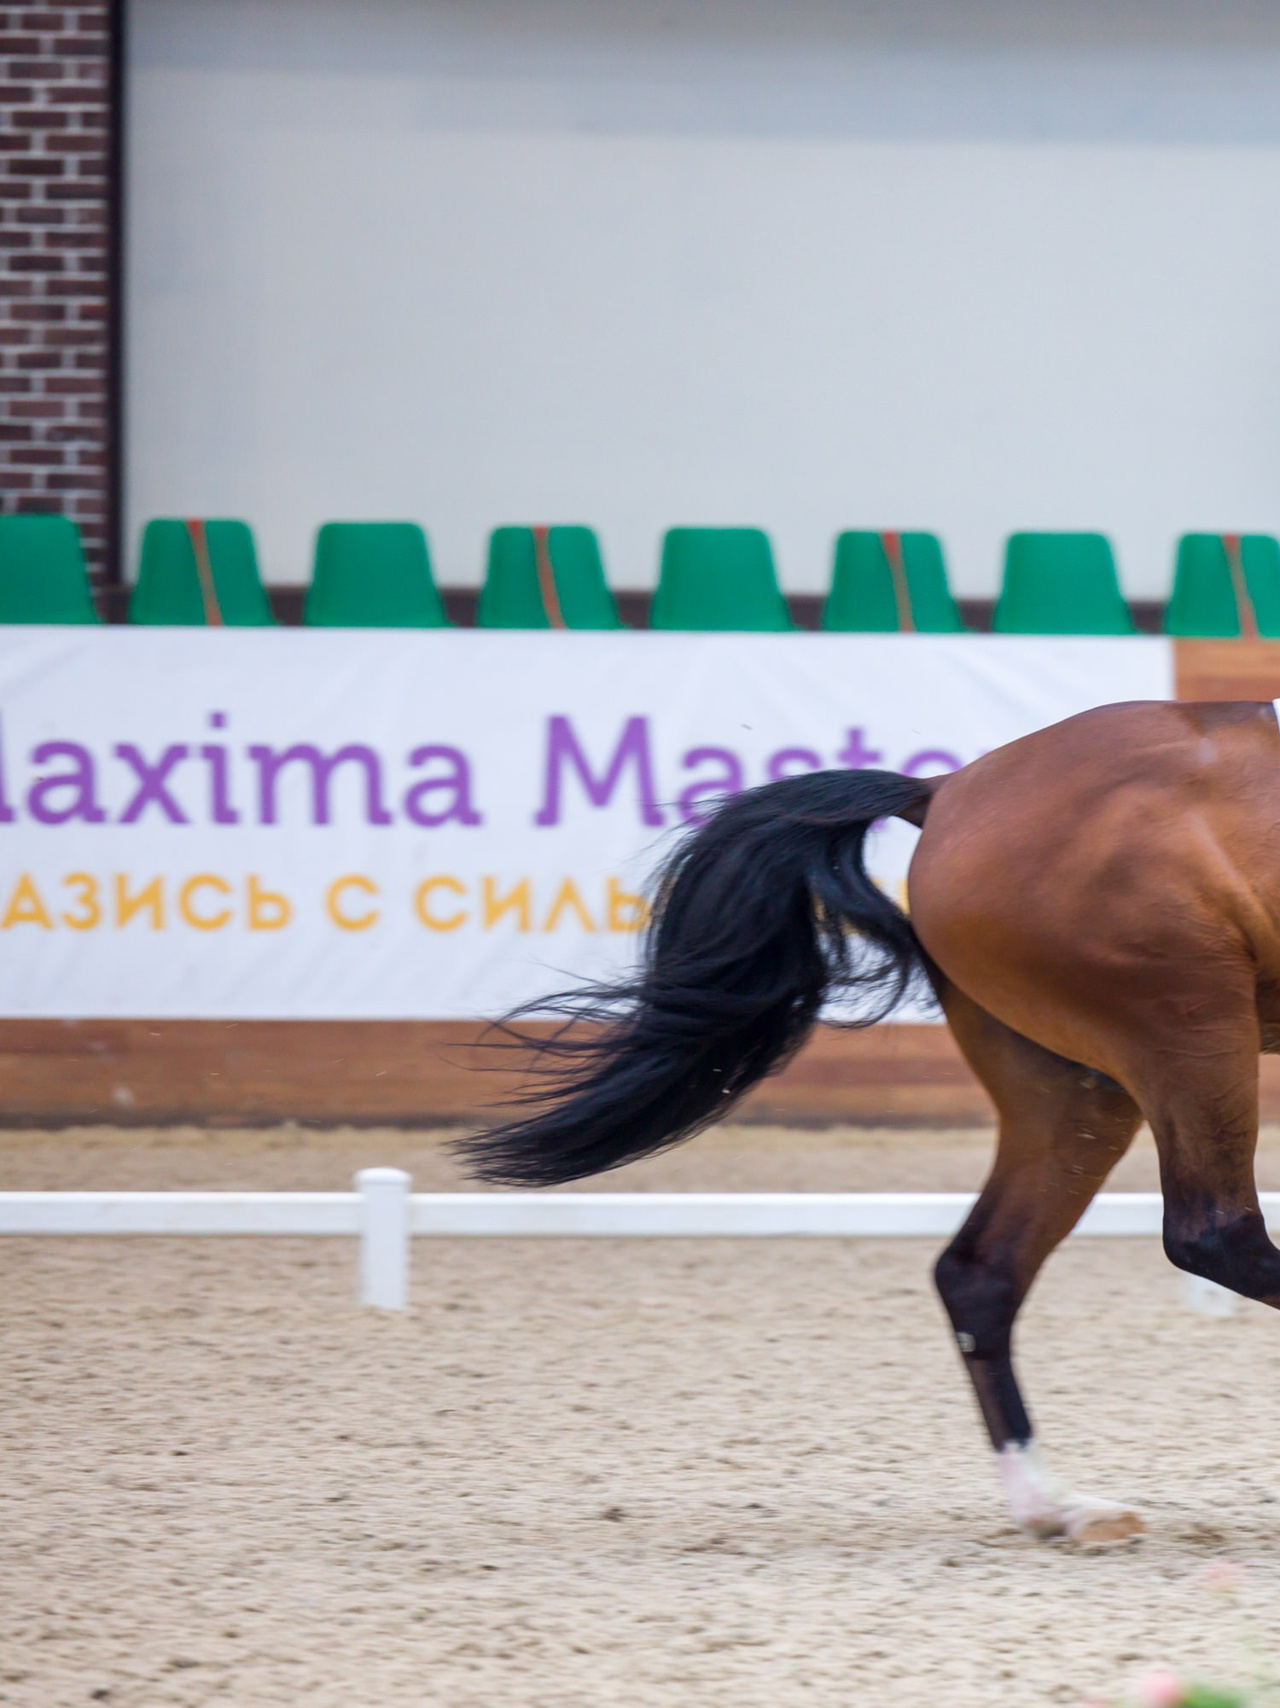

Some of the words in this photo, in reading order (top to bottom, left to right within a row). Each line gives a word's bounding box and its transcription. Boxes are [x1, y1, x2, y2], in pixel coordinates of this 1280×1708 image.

[0, 711, 482, 827] axima
[0, 872, 293, 932] АЗИСЬ
[325, 874, 380, 932] С
[413, 874, 672, 934] СИЛЬ
